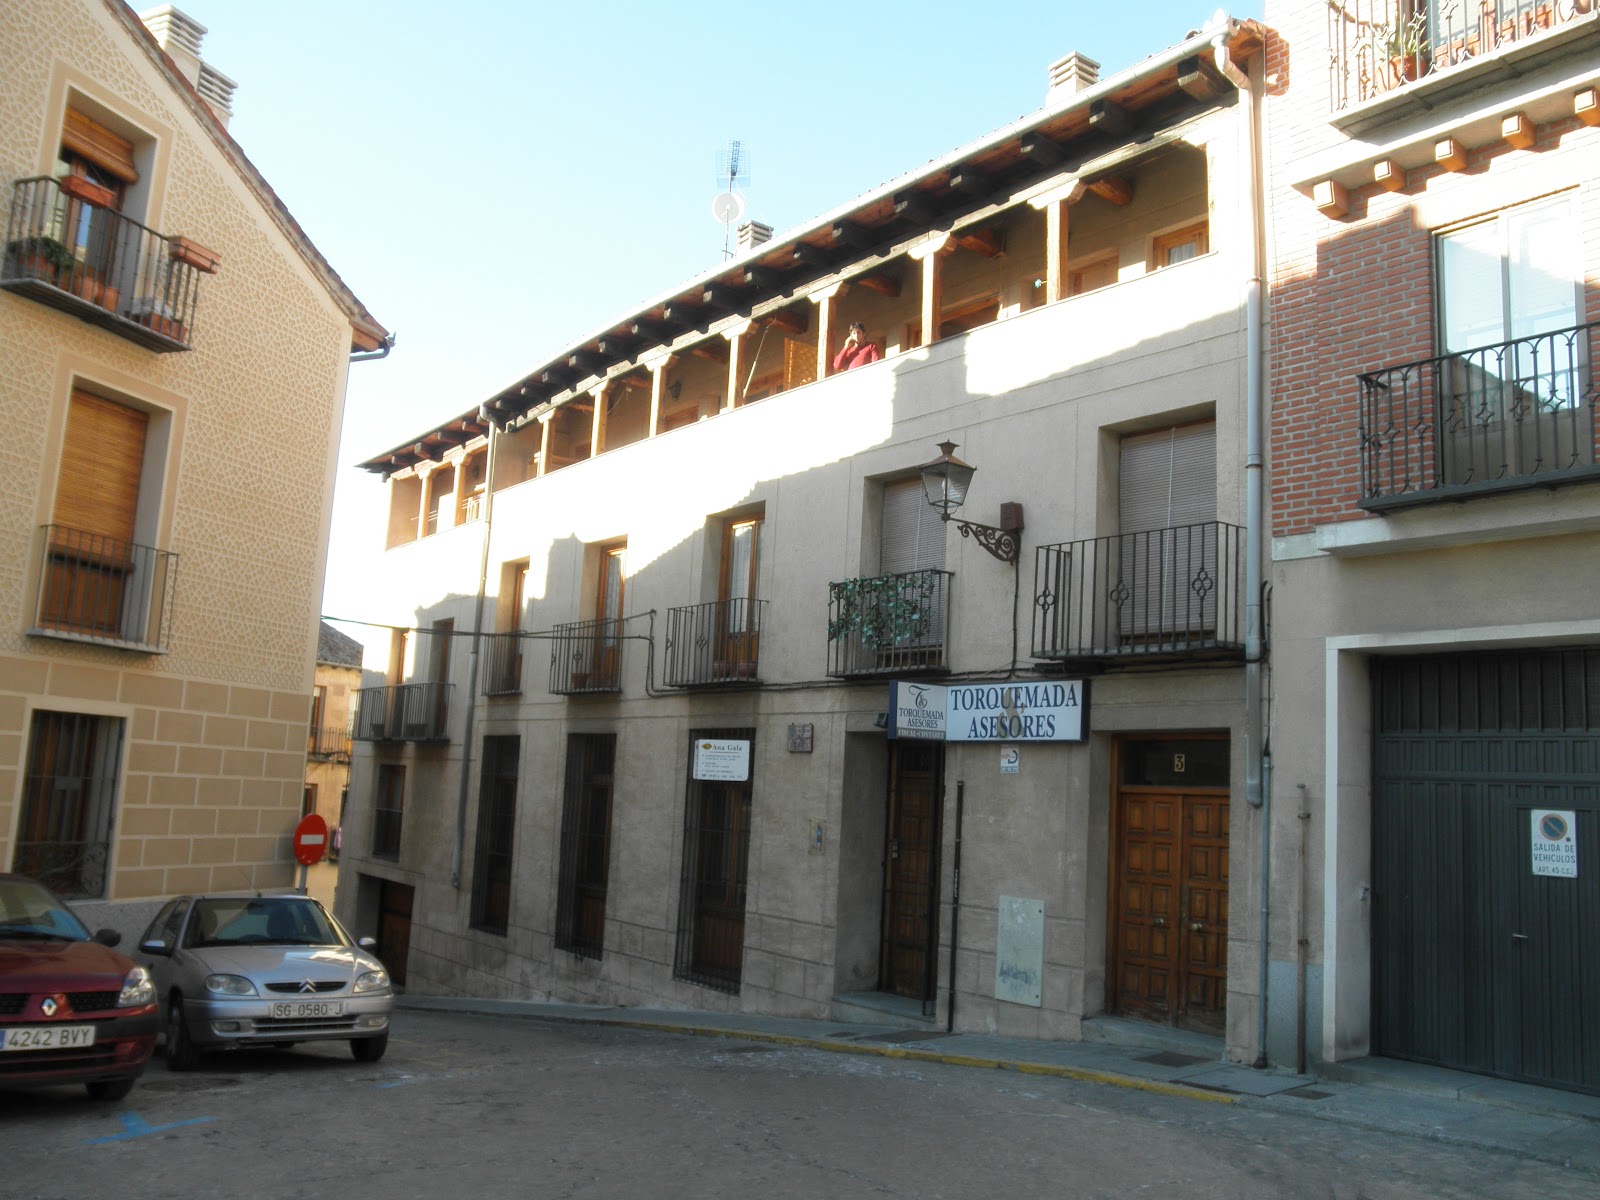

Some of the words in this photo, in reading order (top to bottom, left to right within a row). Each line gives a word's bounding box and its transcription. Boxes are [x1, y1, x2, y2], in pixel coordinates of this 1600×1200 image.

[951, 684, 1078, 711] TORQUEMADA
[899, 707, 944, 720] TORQUEMADA
[907, 718, 938, 729] ASESORES
[967, 714, 1056, 739] ASESORES
[1176, 755, 1184, 771] 3
[1533, 842, 1561, 852] SALIDA
[1564, 844, 1575, 853] DE
[1533, 853, 1576, 864] VEHICULOS
[1551, 866, 1560, 874] 45
[8, 1030, 53, 1047] 4242
[60, 1028, 89, 1045] BVY
